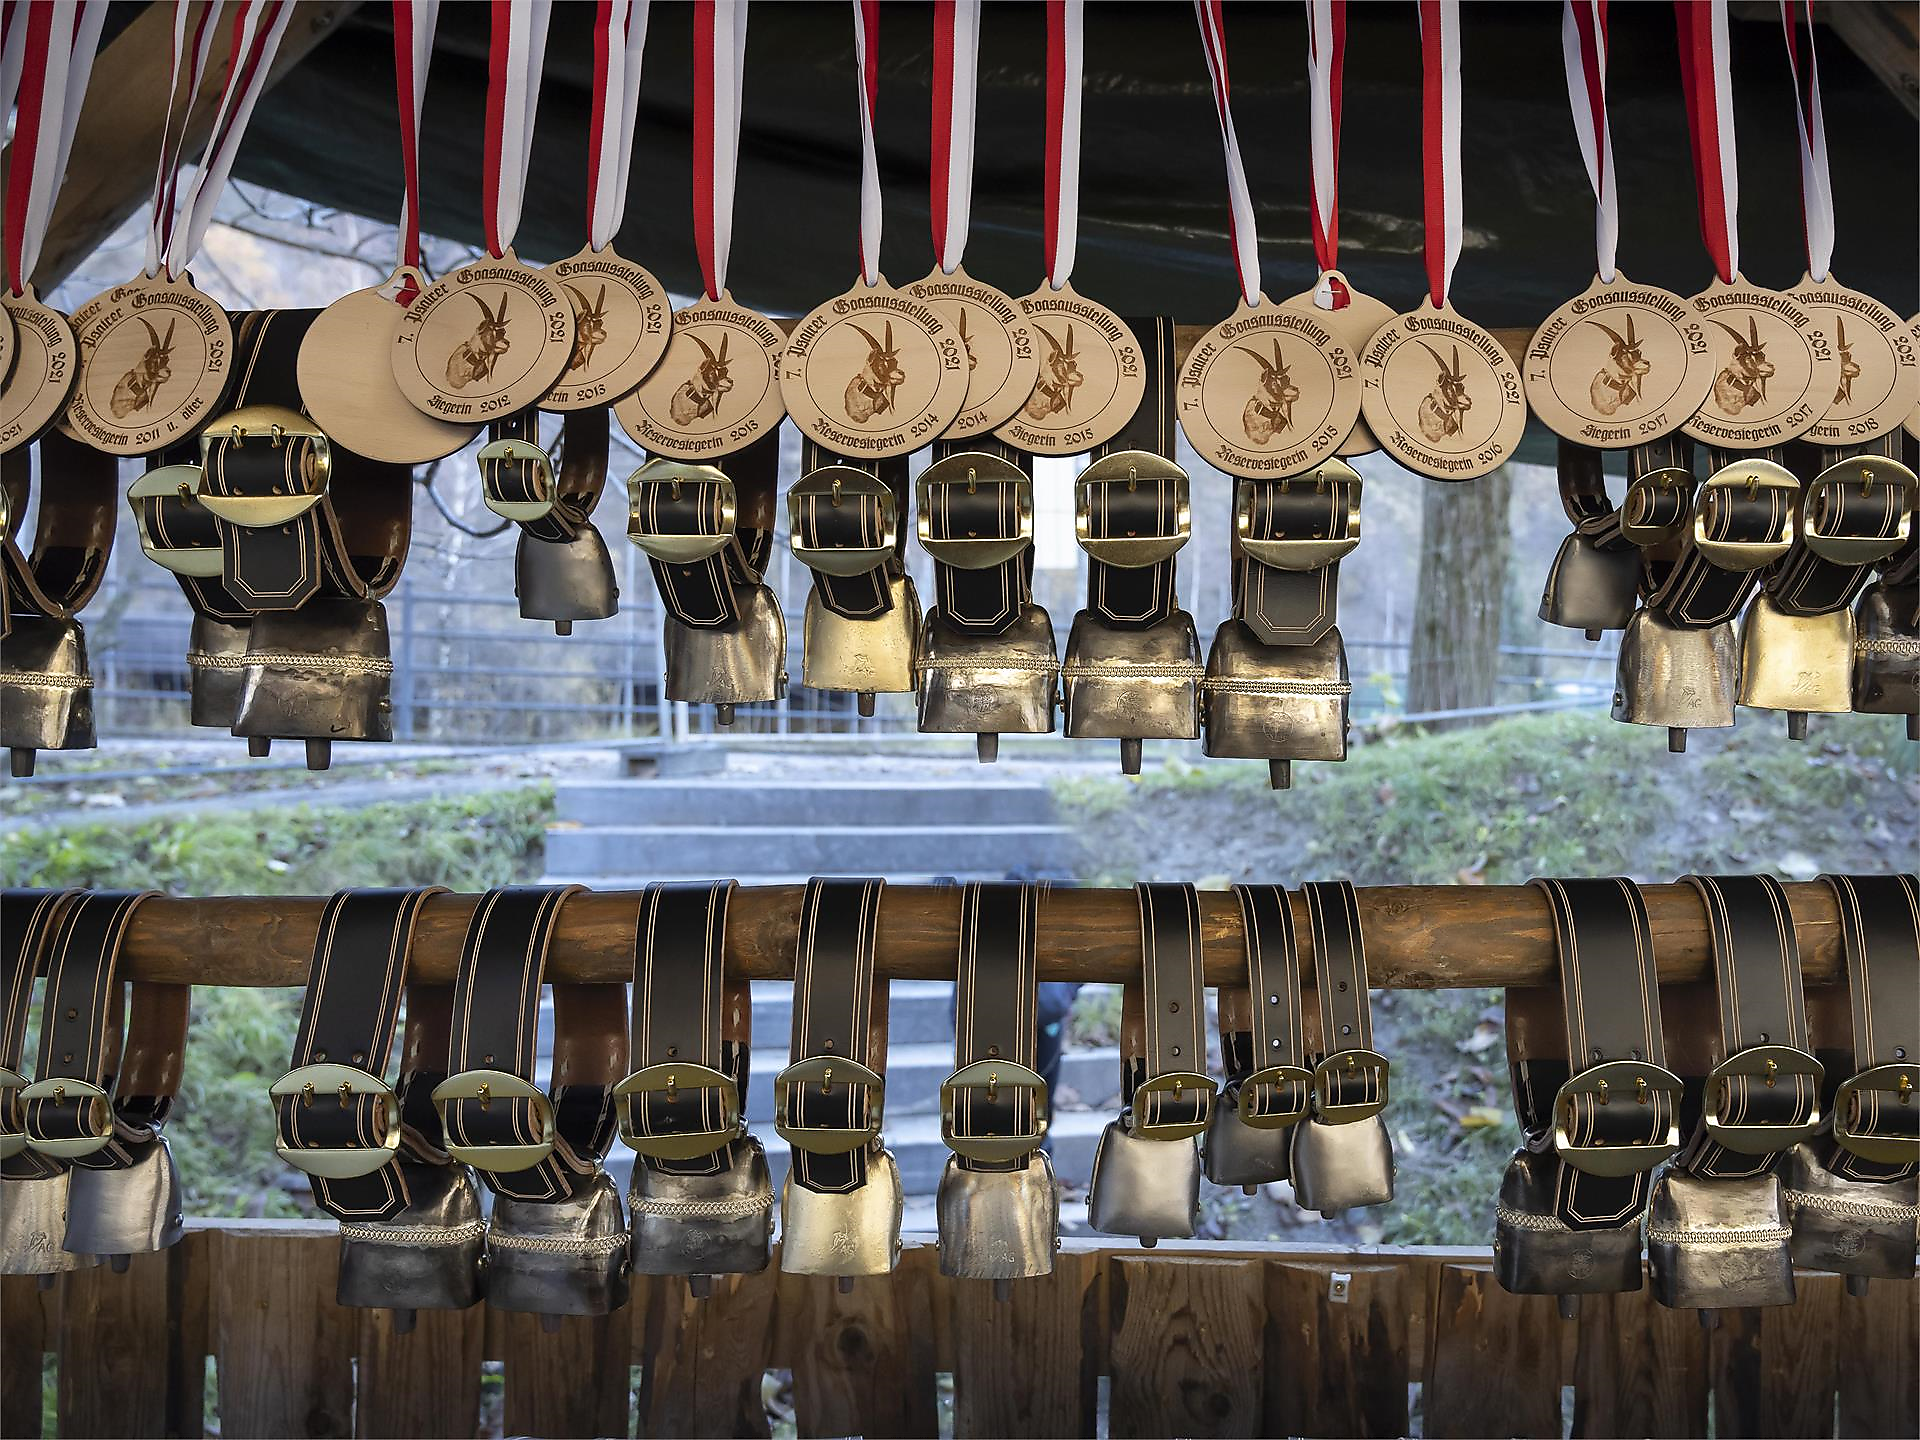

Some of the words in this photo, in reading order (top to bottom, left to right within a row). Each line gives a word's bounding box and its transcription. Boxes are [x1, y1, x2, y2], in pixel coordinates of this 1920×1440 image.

[397, 333, 415, 344] 7.
[457, 267, 558, 309] Goasausstellung
[550, 311, 565, 343] 2021
[556, 261, 655, 301] Goasausstellung
[647, 303, 662, 334] 2021
[785, 368, 802, 380] 7.
[832, 295, 943, 336] Goasausstellung
[939, 338, 961, 370] 2021
[909, 283, 1017, 324] Goasausstellung
[1011, 328, 1032, 360] 2021
[1530, 369, 1546, 382] 7.
[1571, 291, 1686, 322] Goasausstellung
[1682, 323, 1708, 355] 2021
[208, 339, 225, 373] 2021
[1118, 346, 1138, 378] 2021
[1183, 398, 1198, 411] 7.
[1219, 313, 1331, 347] Goasausstellung
[1329, 347, 1352, 380] 2021
[1364, 378, 1379, 389] 7.
[1404, 316, 1504, 367] Goasausstellung
[1501, 372, 1520, 405] 2021
[1807, 330, 1832, 361] 2021
[1892, 335, 1917, 367] 2021
[48, 352, 66, 382] 2021
[427, 394, 473, 415] Siegerin
[480, 394, 511, 413] 2012
[957, 411, 988, 430] 2014
[1786, 403, 1814, 428] 2017
[0, 423, 23, 445] 021
[135, 429, 161, 446] 2011
[635, 419, 724, 453] Reservesiegerin
[730, 419, 759, 441] 2013
[811, 417, 906, 451] Reservesiegerin
[911, 413, 940, 438] 2014
[1008, 425, 1056, 447] Siegerin
[1064, 428, 1094, 445] 2015
[1580, 423, 1631, 442] Siegerin
[1639, 413, 1668, 435] 2017
[1848, 418, 1879, 436] 2018
[1214, 444, 1308, 471] Reservesiegerin
[1312, 425, 1339, 452] 2015
[1389, 430, 1474, 473] Reservesiegerin
[1478, 441, 1503, 465] 2016
